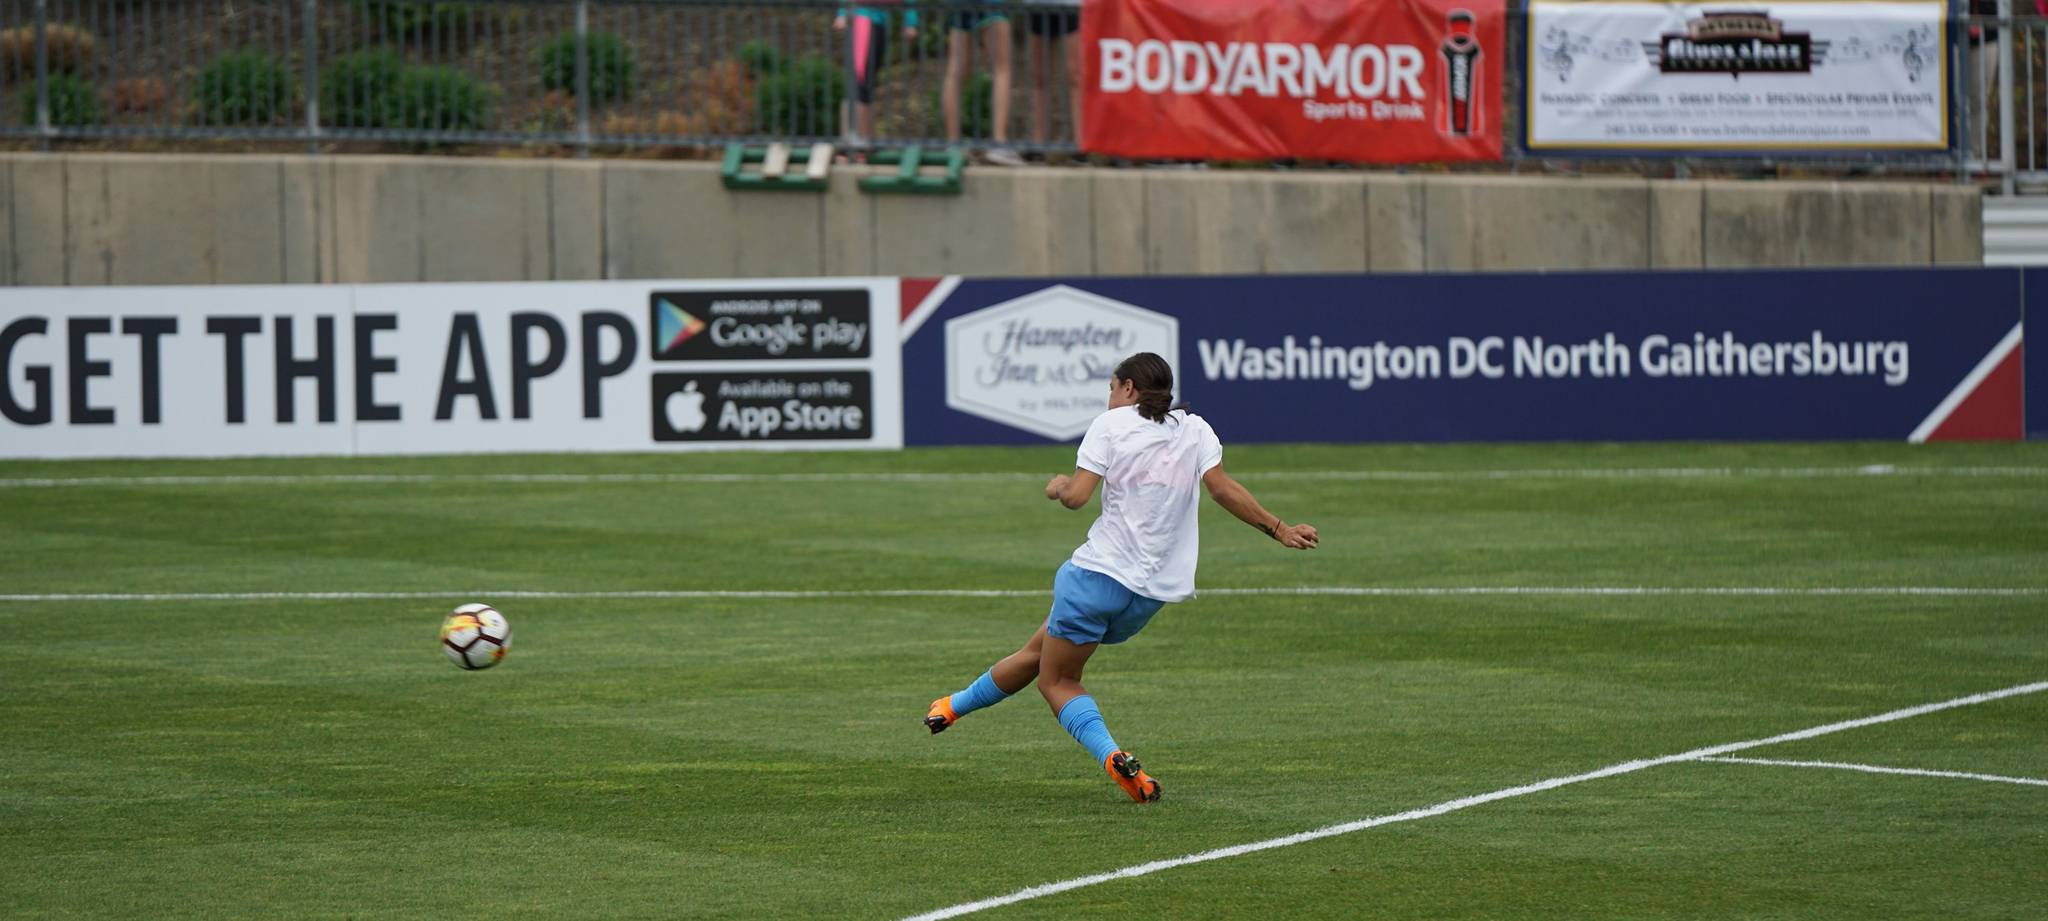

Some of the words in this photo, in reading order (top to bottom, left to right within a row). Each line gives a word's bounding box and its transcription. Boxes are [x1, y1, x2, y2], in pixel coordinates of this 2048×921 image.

[1098, 38, 1426, 98] BODYARMOR
[1303, 100, 1367, 121] Sports
[1372, 100, 1424, 120] Drink
[710, 300, 770, 314] ANDROID
[773, 299, 798, 313] APP
[799, 299, 822, 313] ON
[710, 316, 807, 354] Google
[812, 316, 868, 351] play
[984, 319, 1136, 357] Hampton
[0, 316, 177, 424] GET
[206, 314, 402, 423] THE
[434, 310, 638, 420] APP
[976, 354, 1042, 386] Inn
[1197, 335, 1442, 390] Washington
[1448, 336, 1505, 379] DC
[1513, 334, 1631, 378] North
[1639, 330, 1909, 386] Gaithersburg
[718, 380, 795, 398] Available
[798, 382, 821, 396] on
[823, 379, 852, 396] the
[718, 400, 781, 437] App
[782, 399, 863, 430] Store
